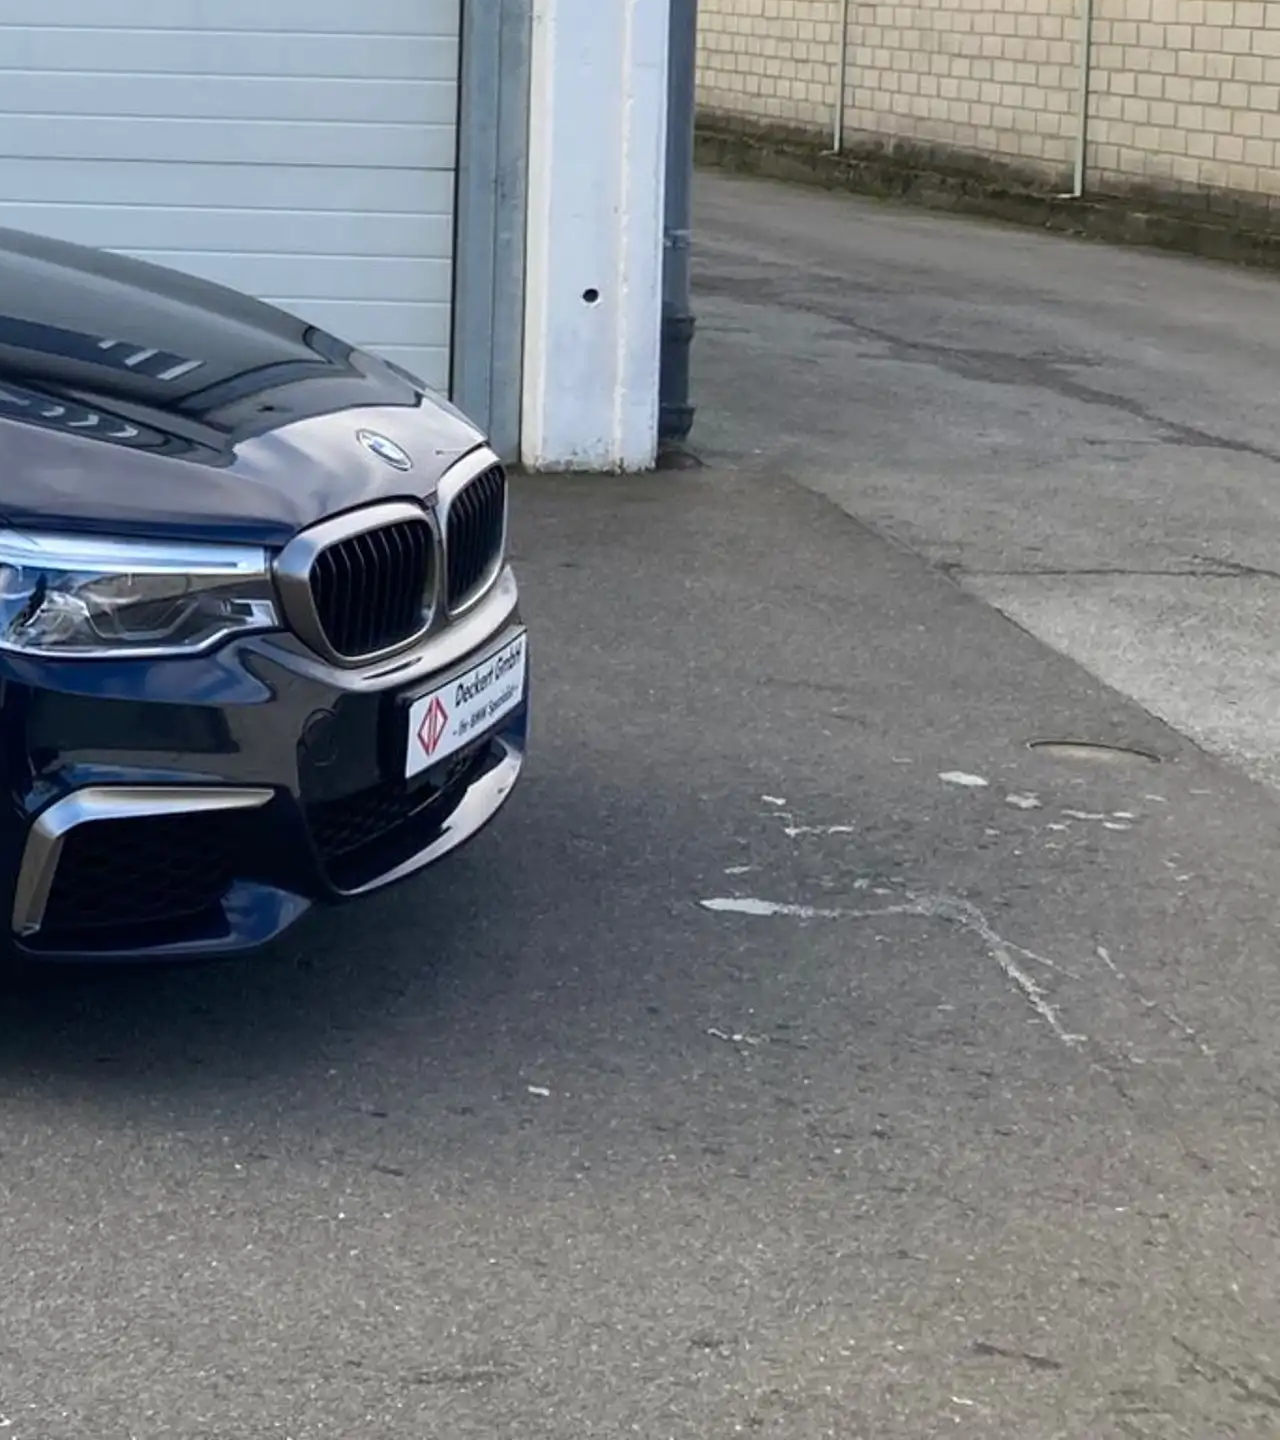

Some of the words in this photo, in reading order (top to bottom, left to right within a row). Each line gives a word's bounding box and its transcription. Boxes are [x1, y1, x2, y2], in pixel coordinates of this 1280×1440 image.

[455, 668, 494, 708] Deckert
[495, 640, 522, 680] GmbH
[470, 706, 487, 728] BMW
